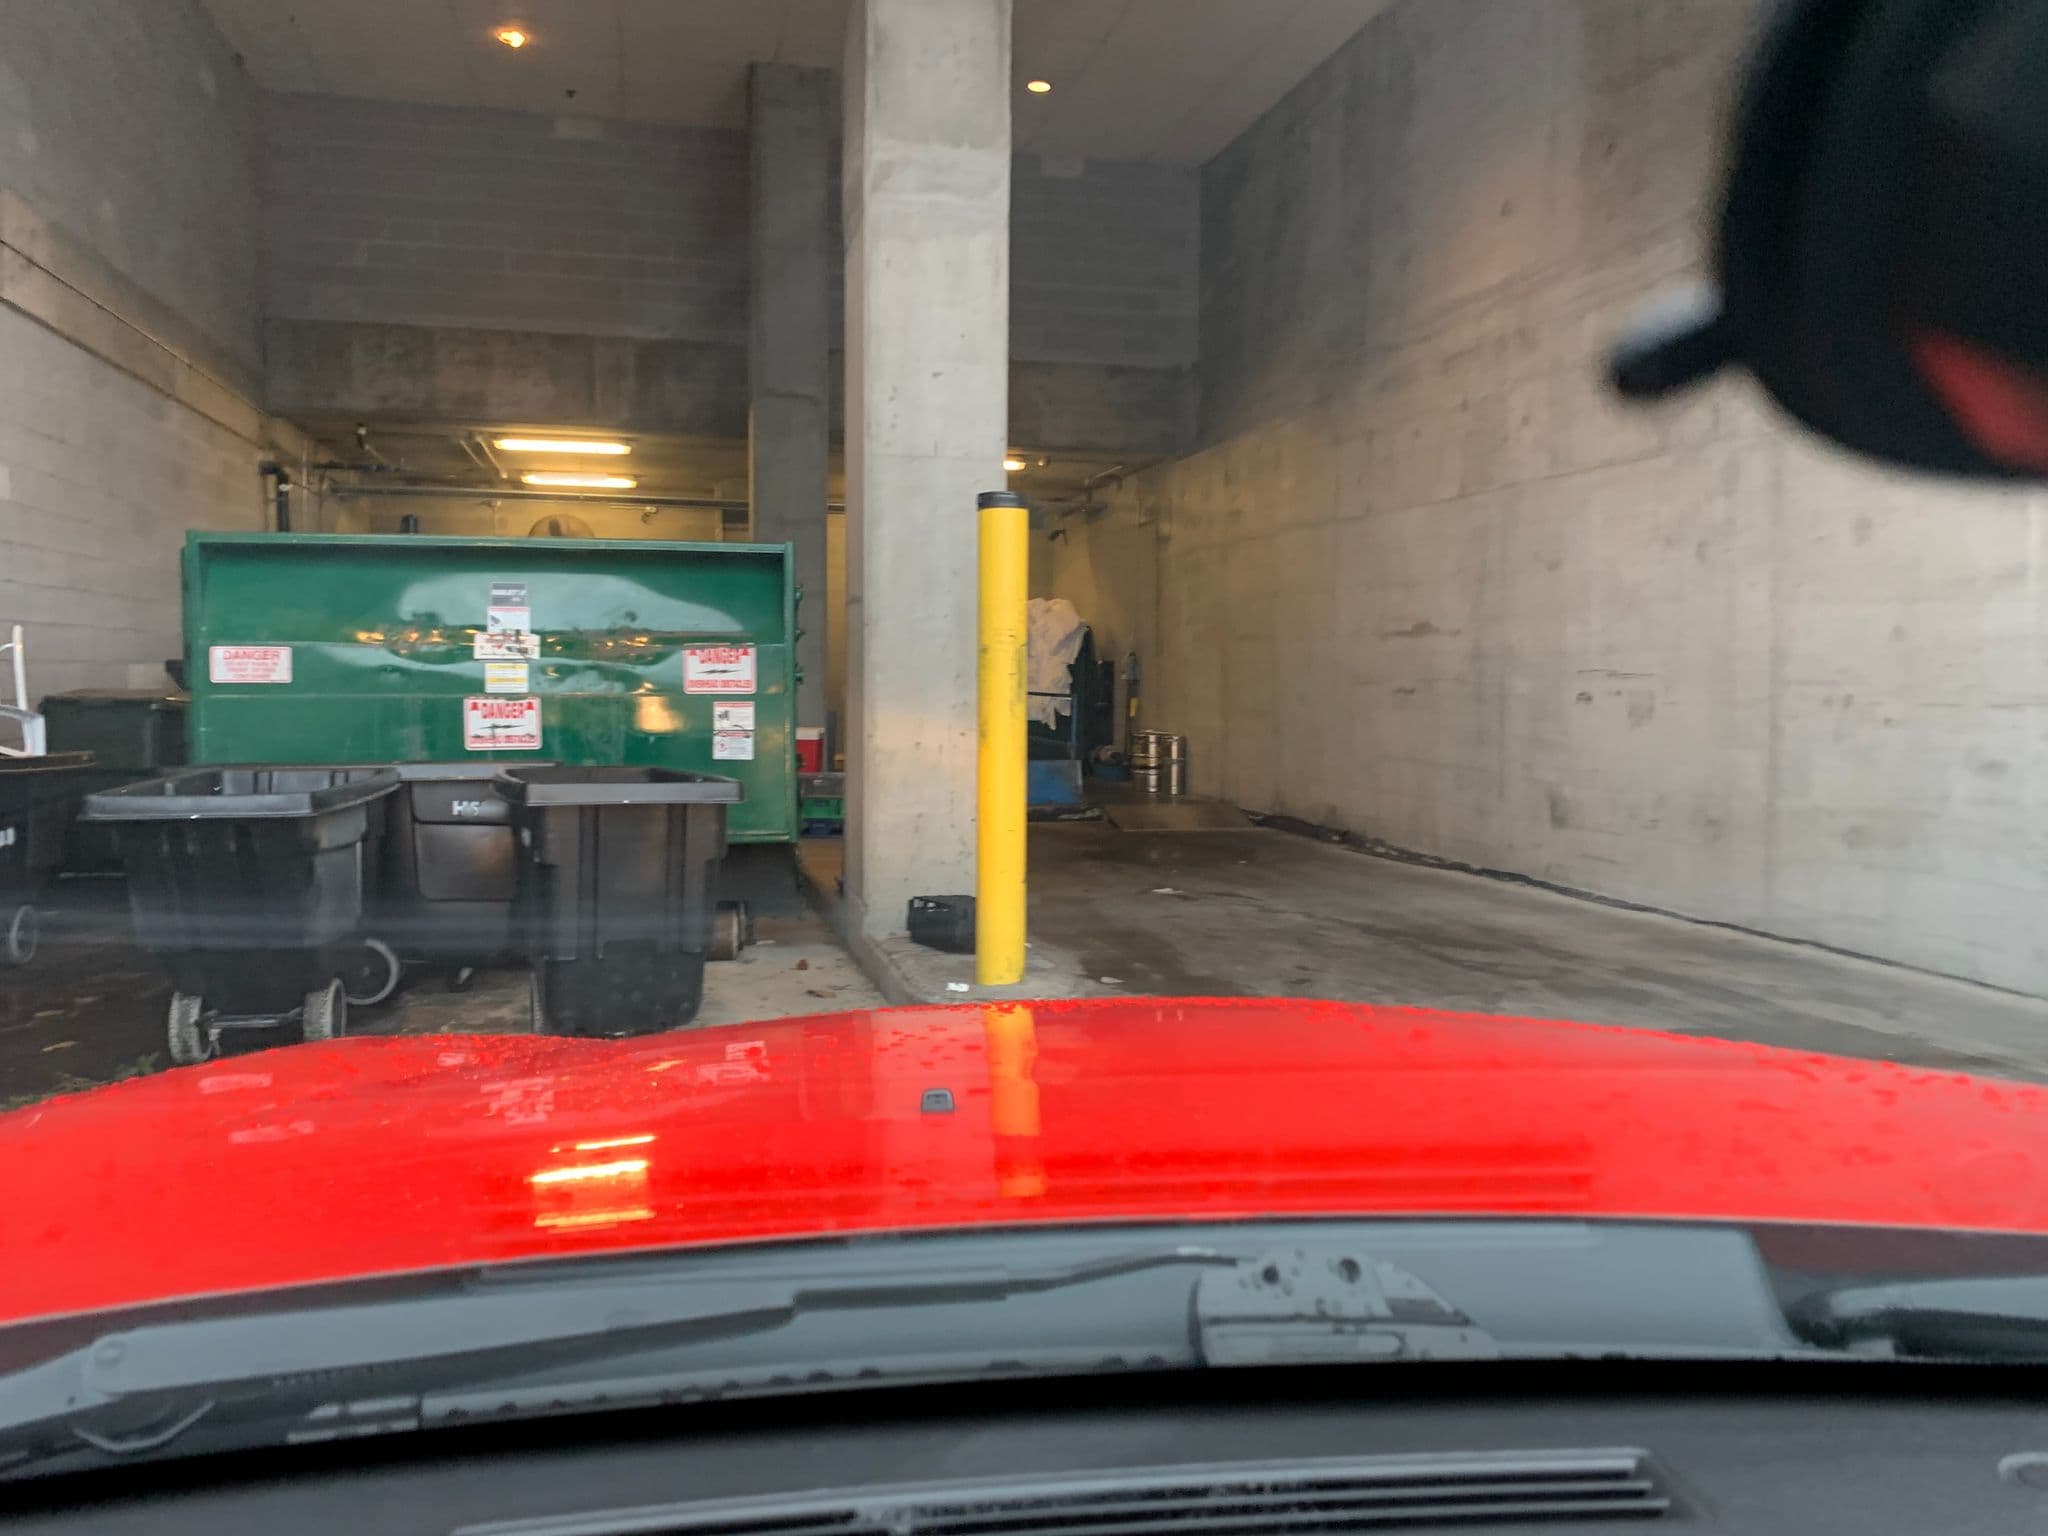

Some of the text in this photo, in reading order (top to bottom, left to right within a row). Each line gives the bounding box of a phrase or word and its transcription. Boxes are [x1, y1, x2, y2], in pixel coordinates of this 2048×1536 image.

[223, 650, 280, 660] DANGER
[699, 648, 741, 664] DANGER
[482, 702, 525, 719] DANGER
